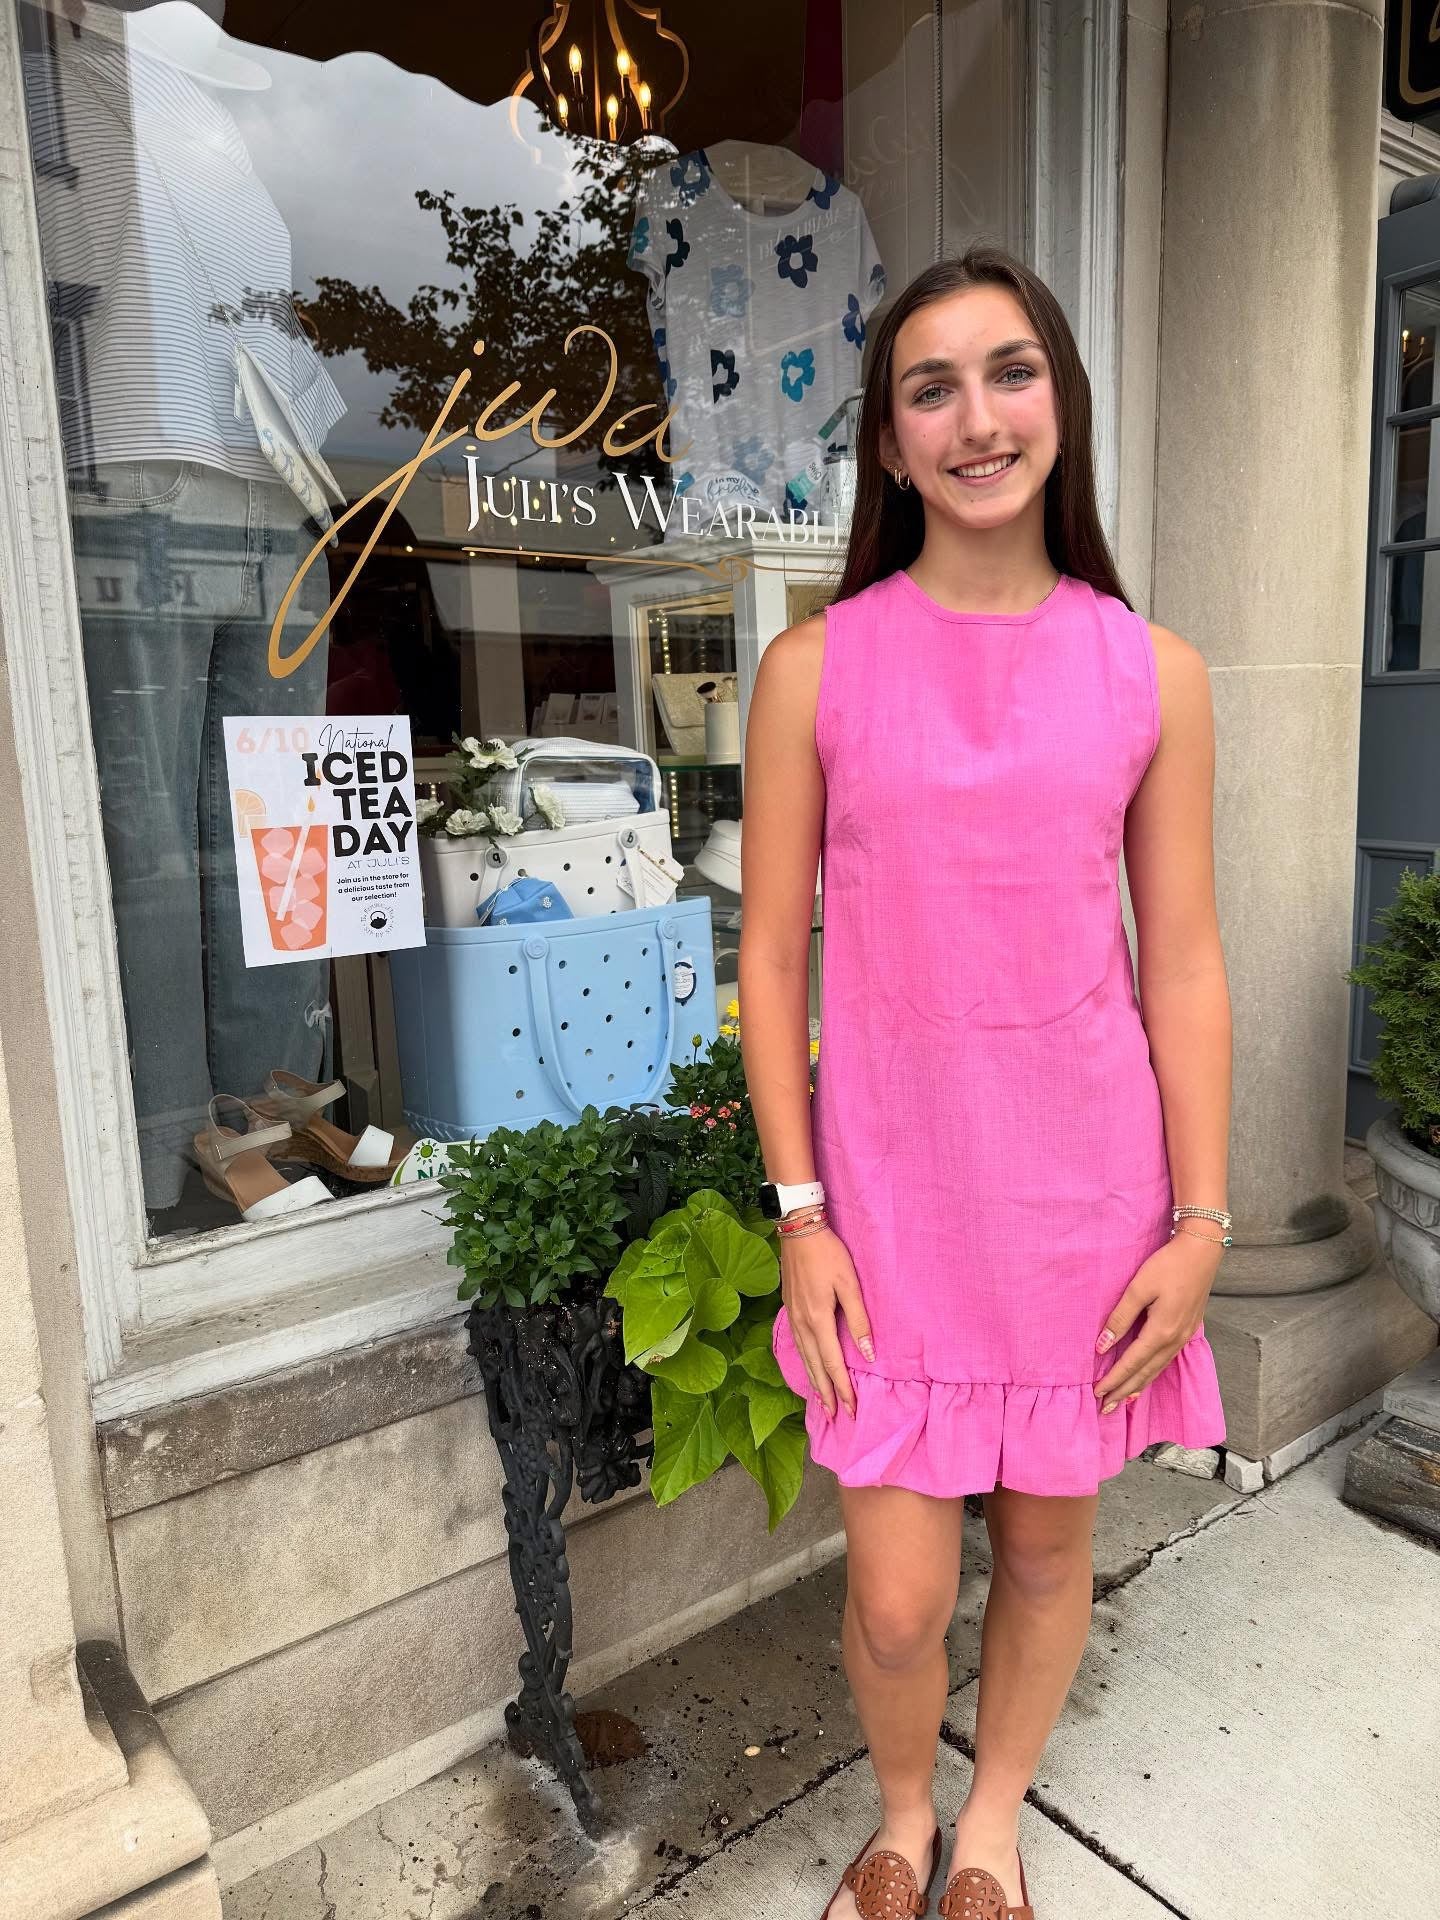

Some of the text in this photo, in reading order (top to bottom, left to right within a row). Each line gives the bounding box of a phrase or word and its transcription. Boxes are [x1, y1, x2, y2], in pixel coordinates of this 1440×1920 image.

[462, 454, 597, 531] JULI'S
[236, 727, 311, 753] 6/10
[319, 723, 394, 763] National
[302, 750, 408, 786] ICED
[333, 786, 413, 821] TEA
[332, 820, 413, 857] DAY
[347, 859, 361, 869] AT
[336, 876, 351, 885] Join
[343, 885, 375, 893] delicious
[364, 891, 397, 900] selection!
